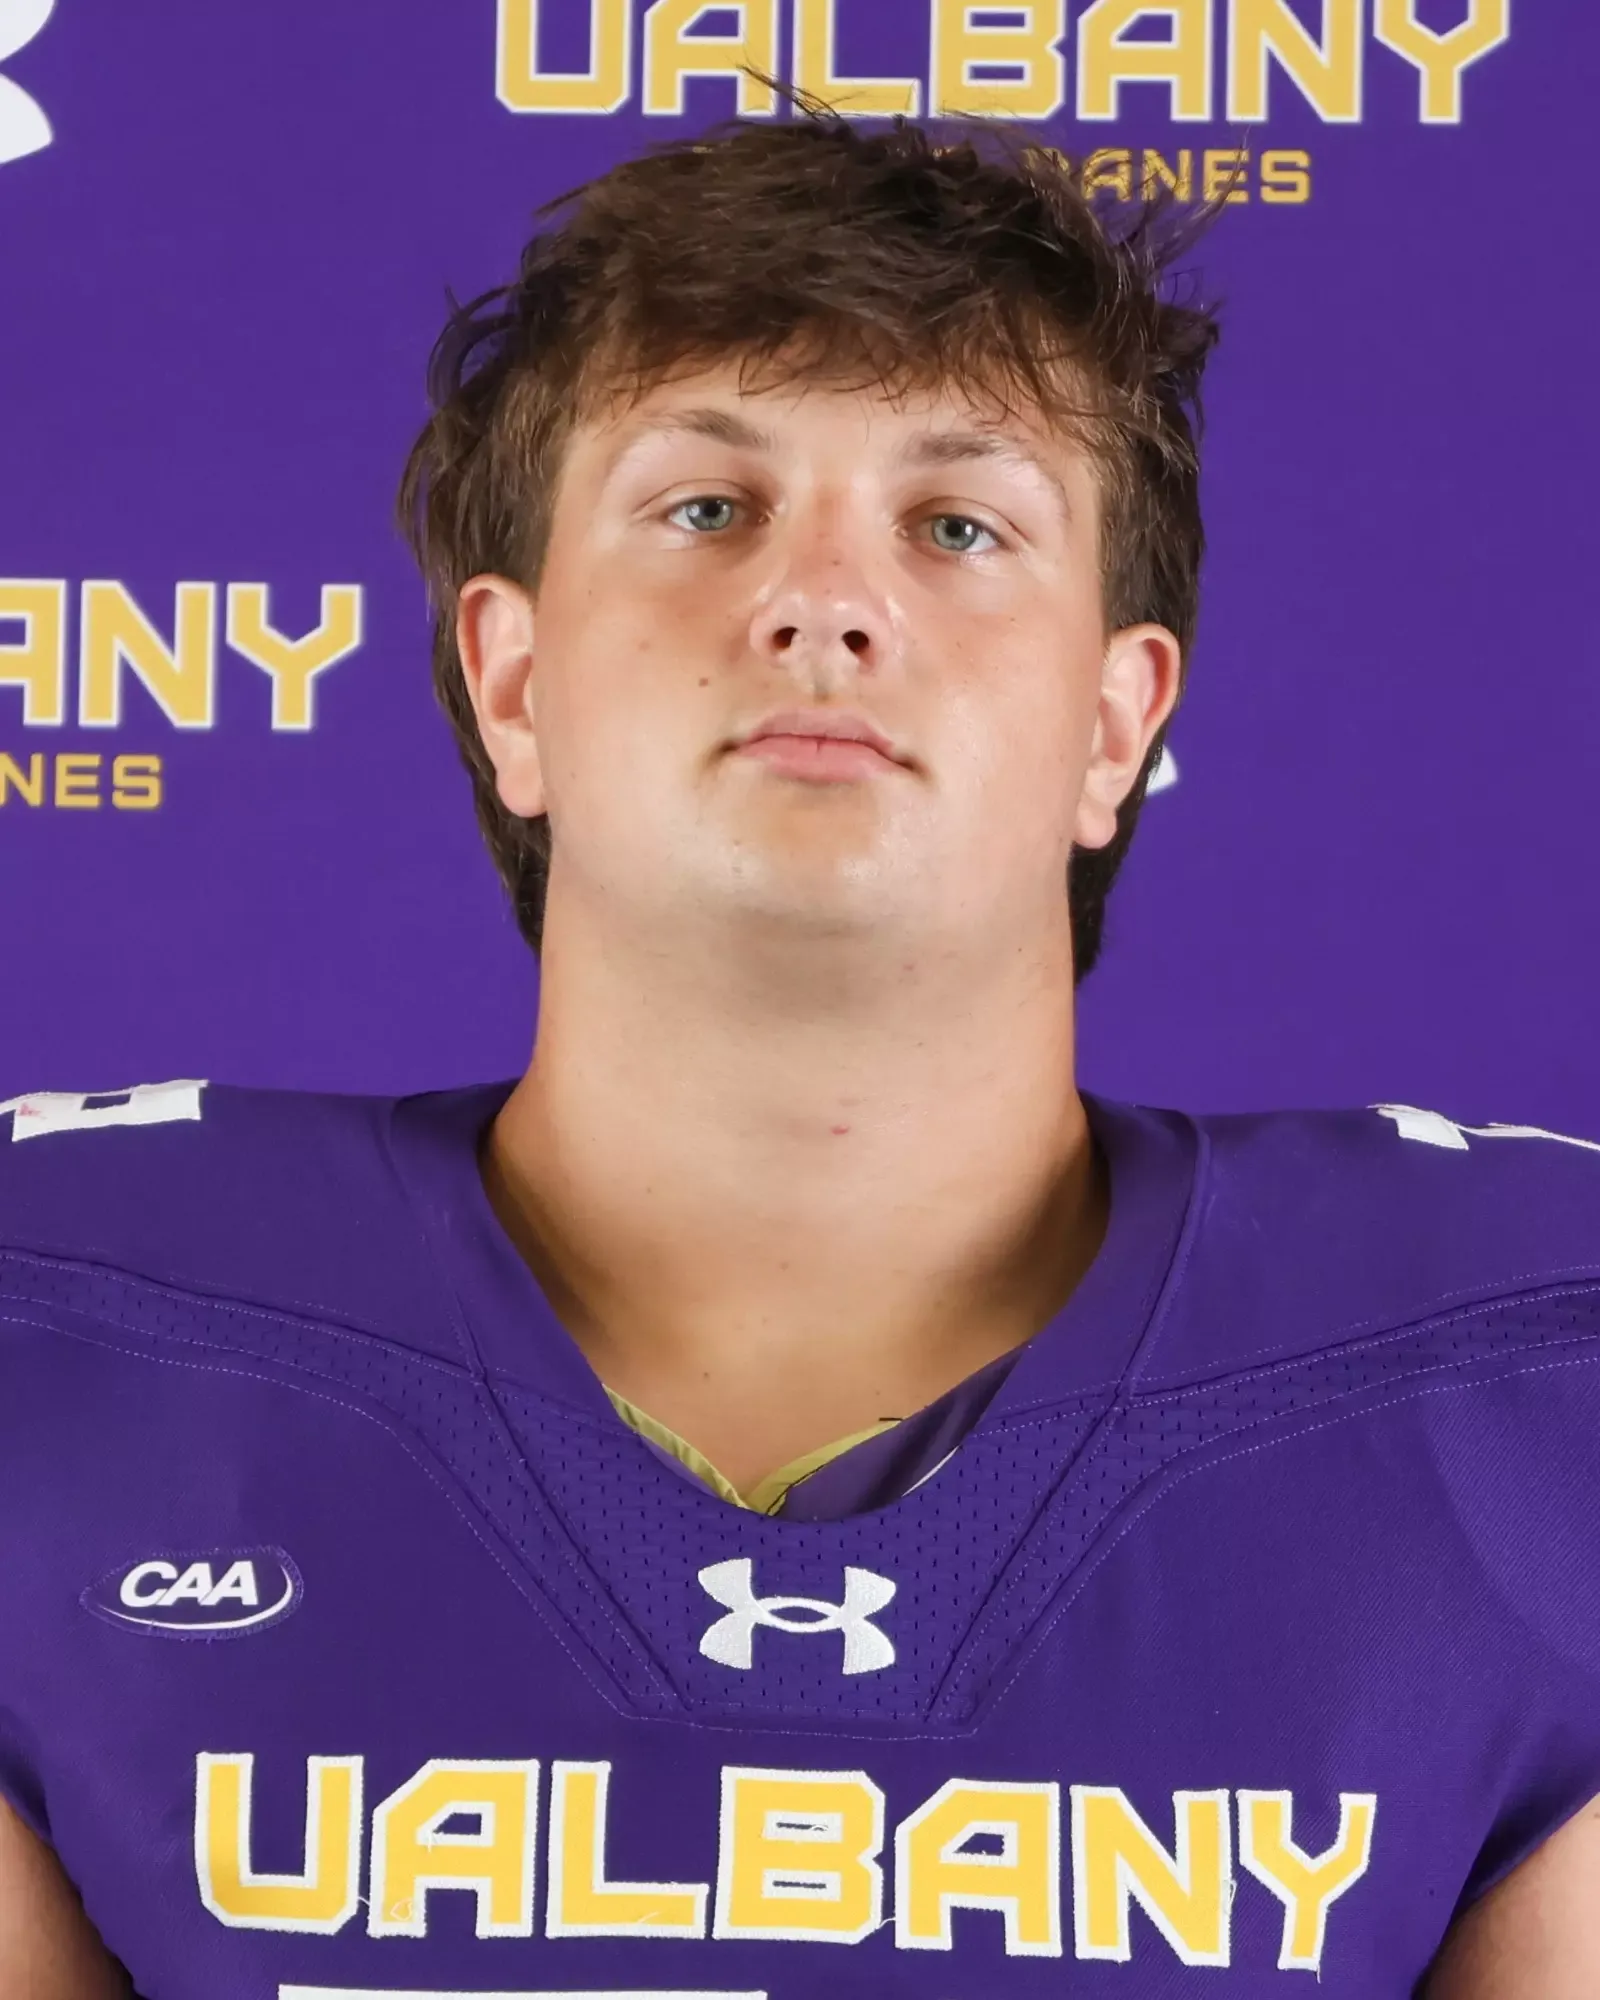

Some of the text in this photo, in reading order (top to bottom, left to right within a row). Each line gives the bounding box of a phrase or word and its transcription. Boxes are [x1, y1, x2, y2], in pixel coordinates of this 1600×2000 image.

[495, 0, 1511, 125] UALBANY
[119, 1560, 259, 1608] CAA
[194, 1751, 1378, 1974] UALBANY
